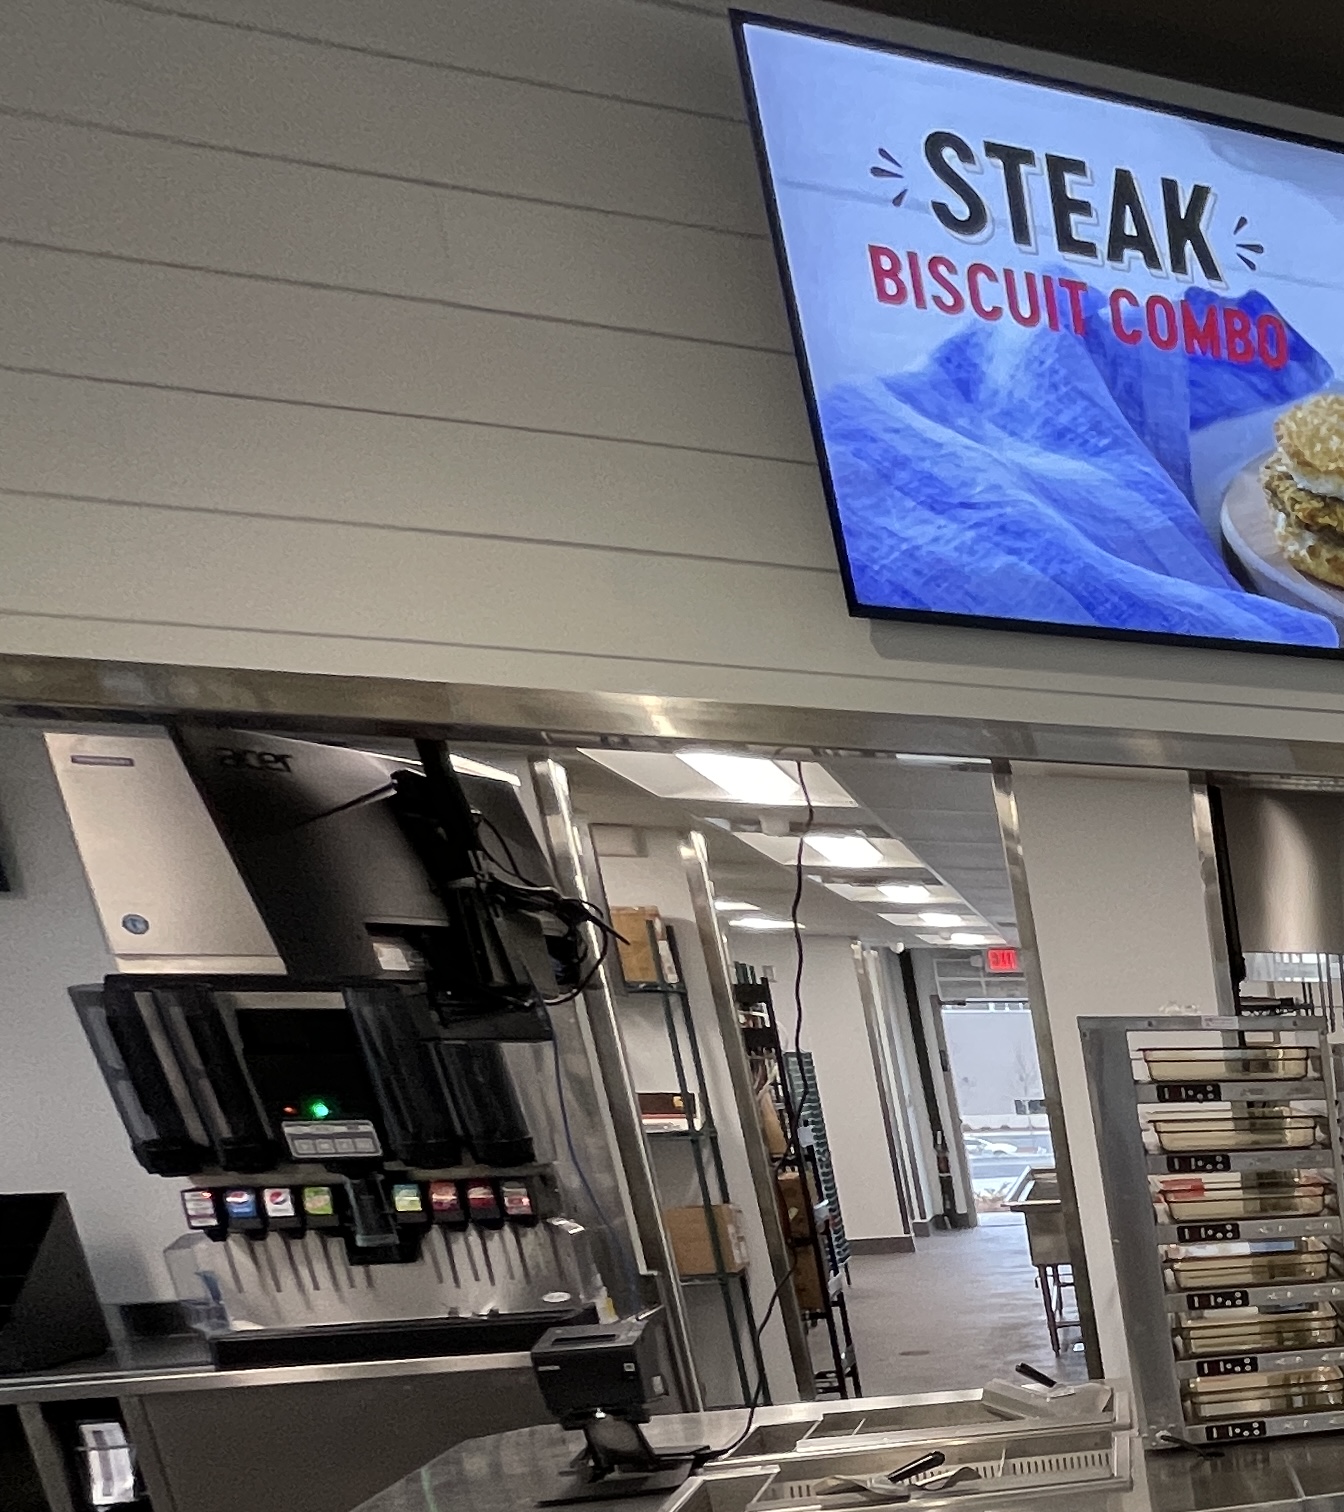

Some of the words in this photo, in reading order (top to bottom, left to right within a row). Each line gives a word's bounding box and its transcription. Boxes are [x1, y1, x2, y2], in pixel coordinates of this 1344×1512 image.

[923, 130, 1226, 286] STEAK
[868, 244, 1088, 335] BISCUIT
[1109, 288, 1289, 370] COMBO
[214, 746, 293, 773] acer
